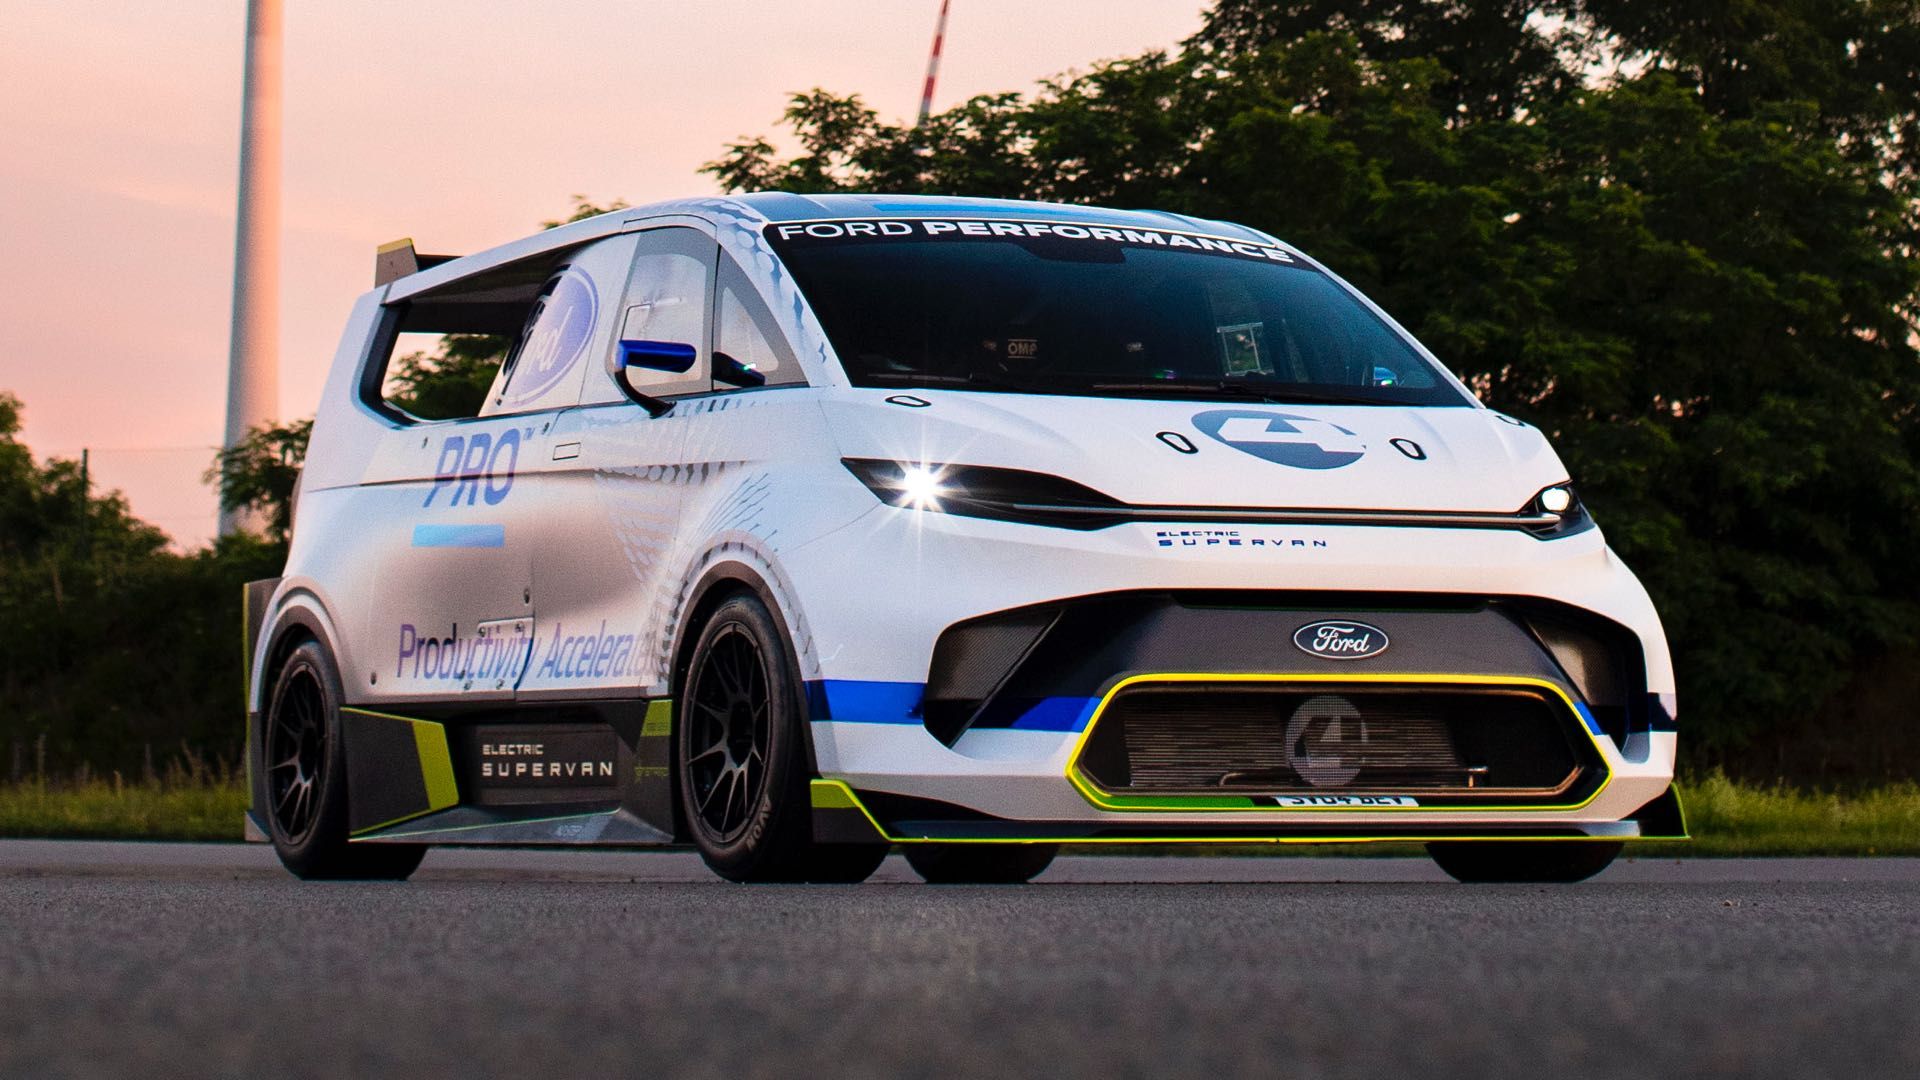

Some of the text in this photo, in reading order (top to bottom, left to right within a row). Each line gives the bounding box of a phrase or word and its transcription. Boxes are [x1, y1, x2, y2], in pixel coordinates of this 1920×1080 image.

[778, 221, 1294, 264] FORD PERFORMANCE
[1007, 341, 1038, 356] OMP
[1158, 539, 1327, 547] SUPERVAN
[1312, 626, 1370, 652] Ford
[396, 622, 543, 691] Productivity
[482, 744, 544, 756] ELECTRIC
[482, 761, 613, 777] SUPERVAN
